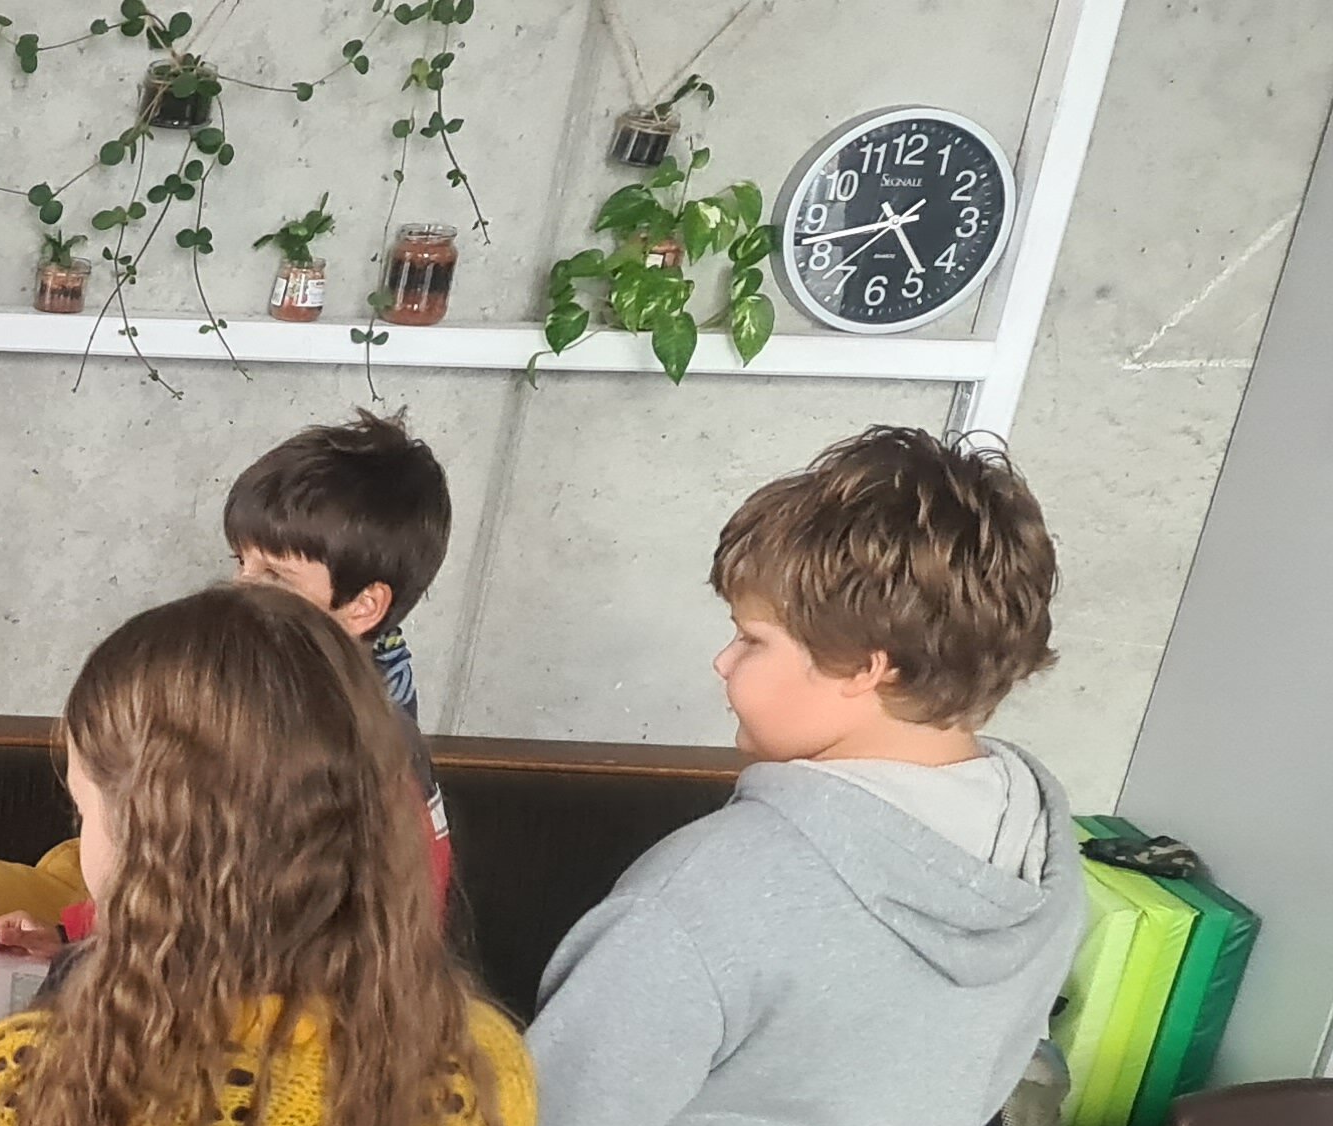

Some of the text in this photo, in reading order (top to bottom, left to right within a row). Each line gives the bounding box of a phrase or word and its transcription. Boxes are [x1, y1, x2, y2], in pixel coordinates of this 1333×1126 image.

[860, 143, 887, 174] 11
[893, 133, 929, 165] 12
[937, 144, 952, 176] 1
[827, 169, 859, 201] 10
[880, 174, 923, 187] SEGNALE
[951, 170, 977, 201] 2
[804, 204, 828, 234] 9
[955, 207, 980, 237] 3
[809, 241, 832, 271] 8
[934, 243, 957, 274] 4
[833, 265, 857, 295] 7
[864, 275, 889, 306] 6
[901, 267, 926, 298] 5
